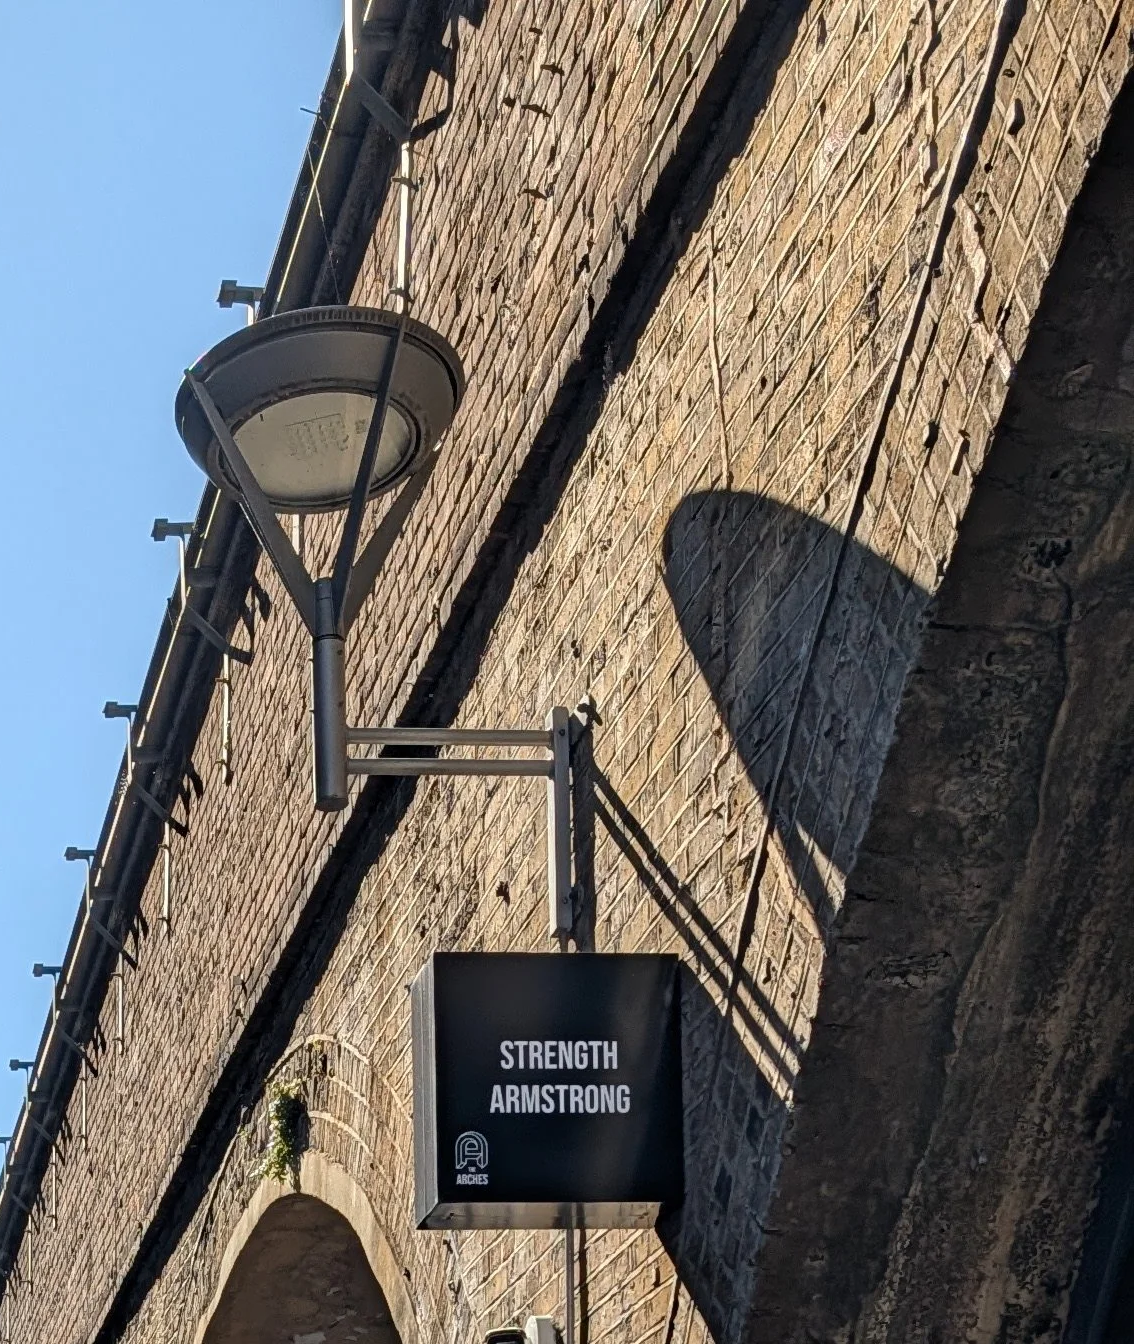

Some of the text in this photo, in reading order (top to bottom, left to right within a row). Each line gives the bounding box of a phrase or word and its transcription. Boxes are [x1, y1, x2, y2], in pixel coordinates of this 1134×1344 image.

[499, 1040, 618, 1070] STRENGTH
[489, 1084, 631, 1114] ARMSTRONG
[456, 1173, 488, 1185] ARCHES
